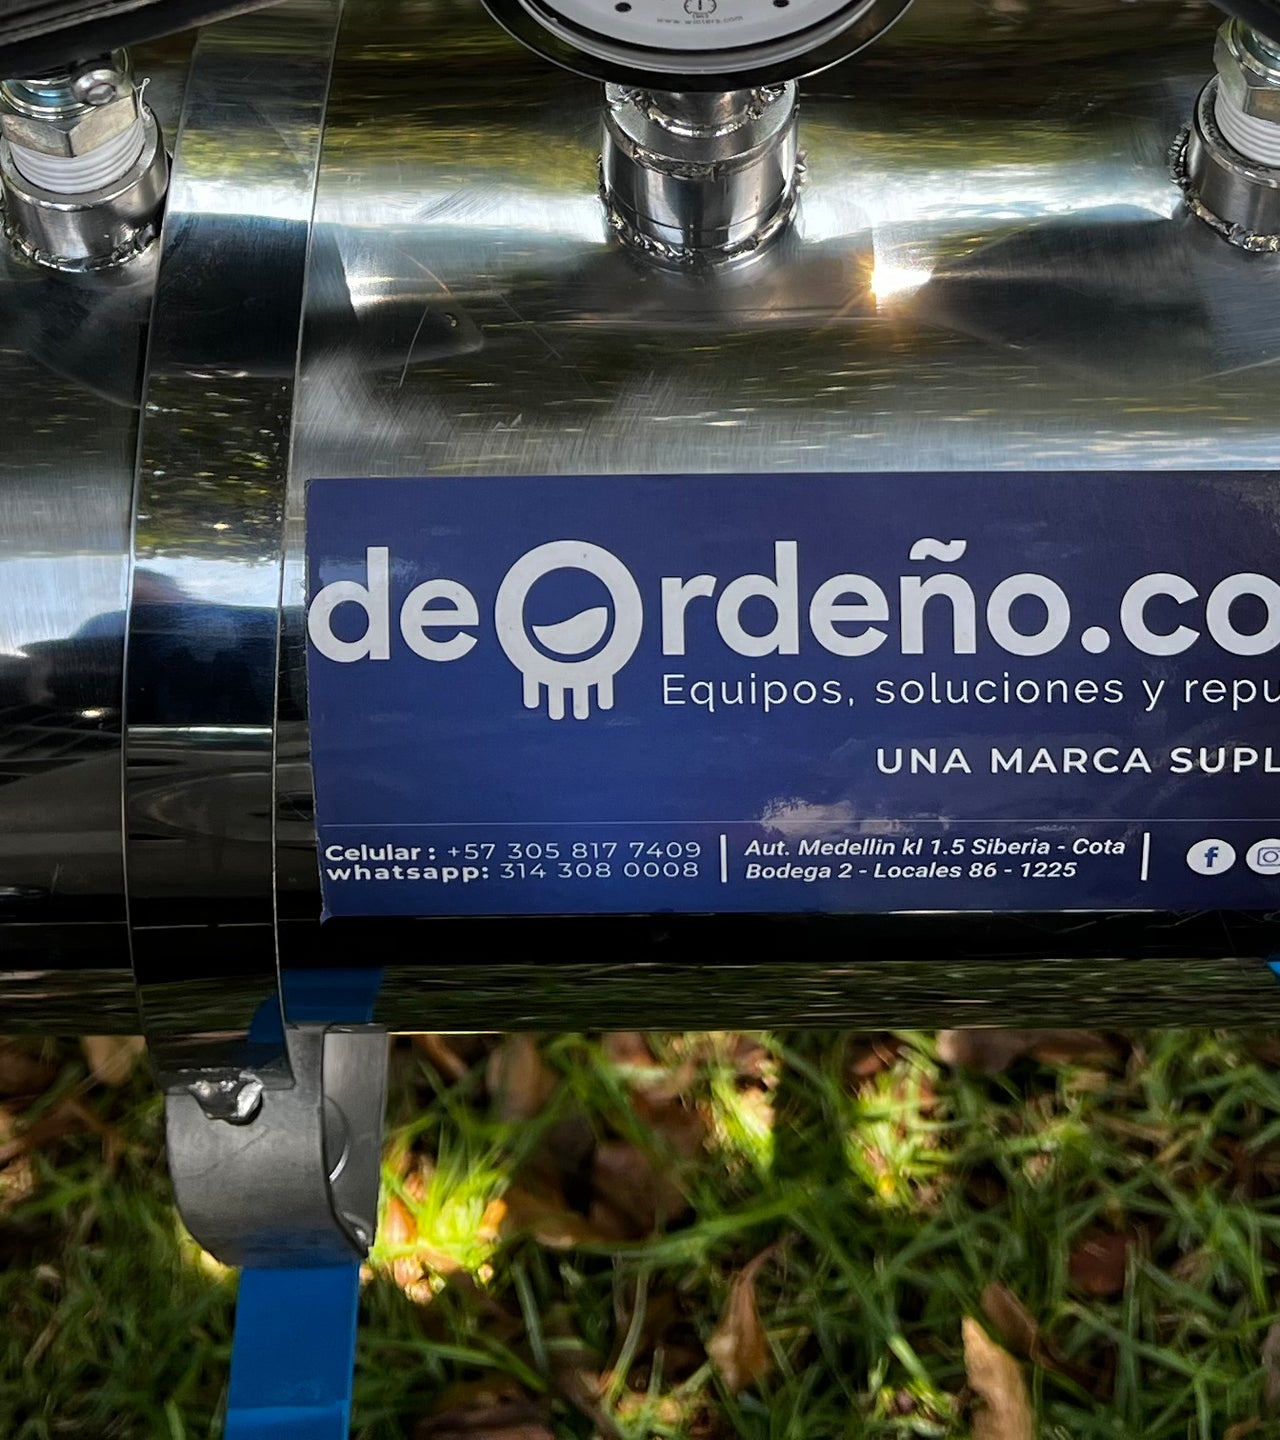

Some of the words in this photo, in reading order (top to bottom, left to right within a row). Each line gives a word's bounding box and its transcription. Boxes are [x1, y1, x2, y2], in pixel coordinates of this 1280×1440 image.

[663, 672, 854, 713] Equipos,
[875, 671, 1124, 704] soluciones
[1142, 679, 1165, 712] y
[877, 748, 972, 774] UNA
[991, 747, 1152, 774] MARCA
[447, 843, 496, 860] +57
[507, 842, 560, 860] 305
[572, 842, 618, 859] 817
[629, 841, 701, 859] 7409
[743, 839, 790, 856] Aut.
[798, 837, 896, 856] Medellin
[931, 838, 966, 855] 1.5
[970, 837, 1051, 855] Siberia
[1072, 837, 1126, 855] Cota
[326, 864, 489, 883] whatsapp:
[500, 863, 547, 879] 314
[558, 862, 612, 879] 308
[623, 861, 699, 878] 0008
[745, 862, 832, 883] Bodega
[837, 862, 853, 879] 2
[873, 861, 962, 879] Locales
[968, 862, 997, 878] 86
[1021, 861, 1078, 878] 1225
